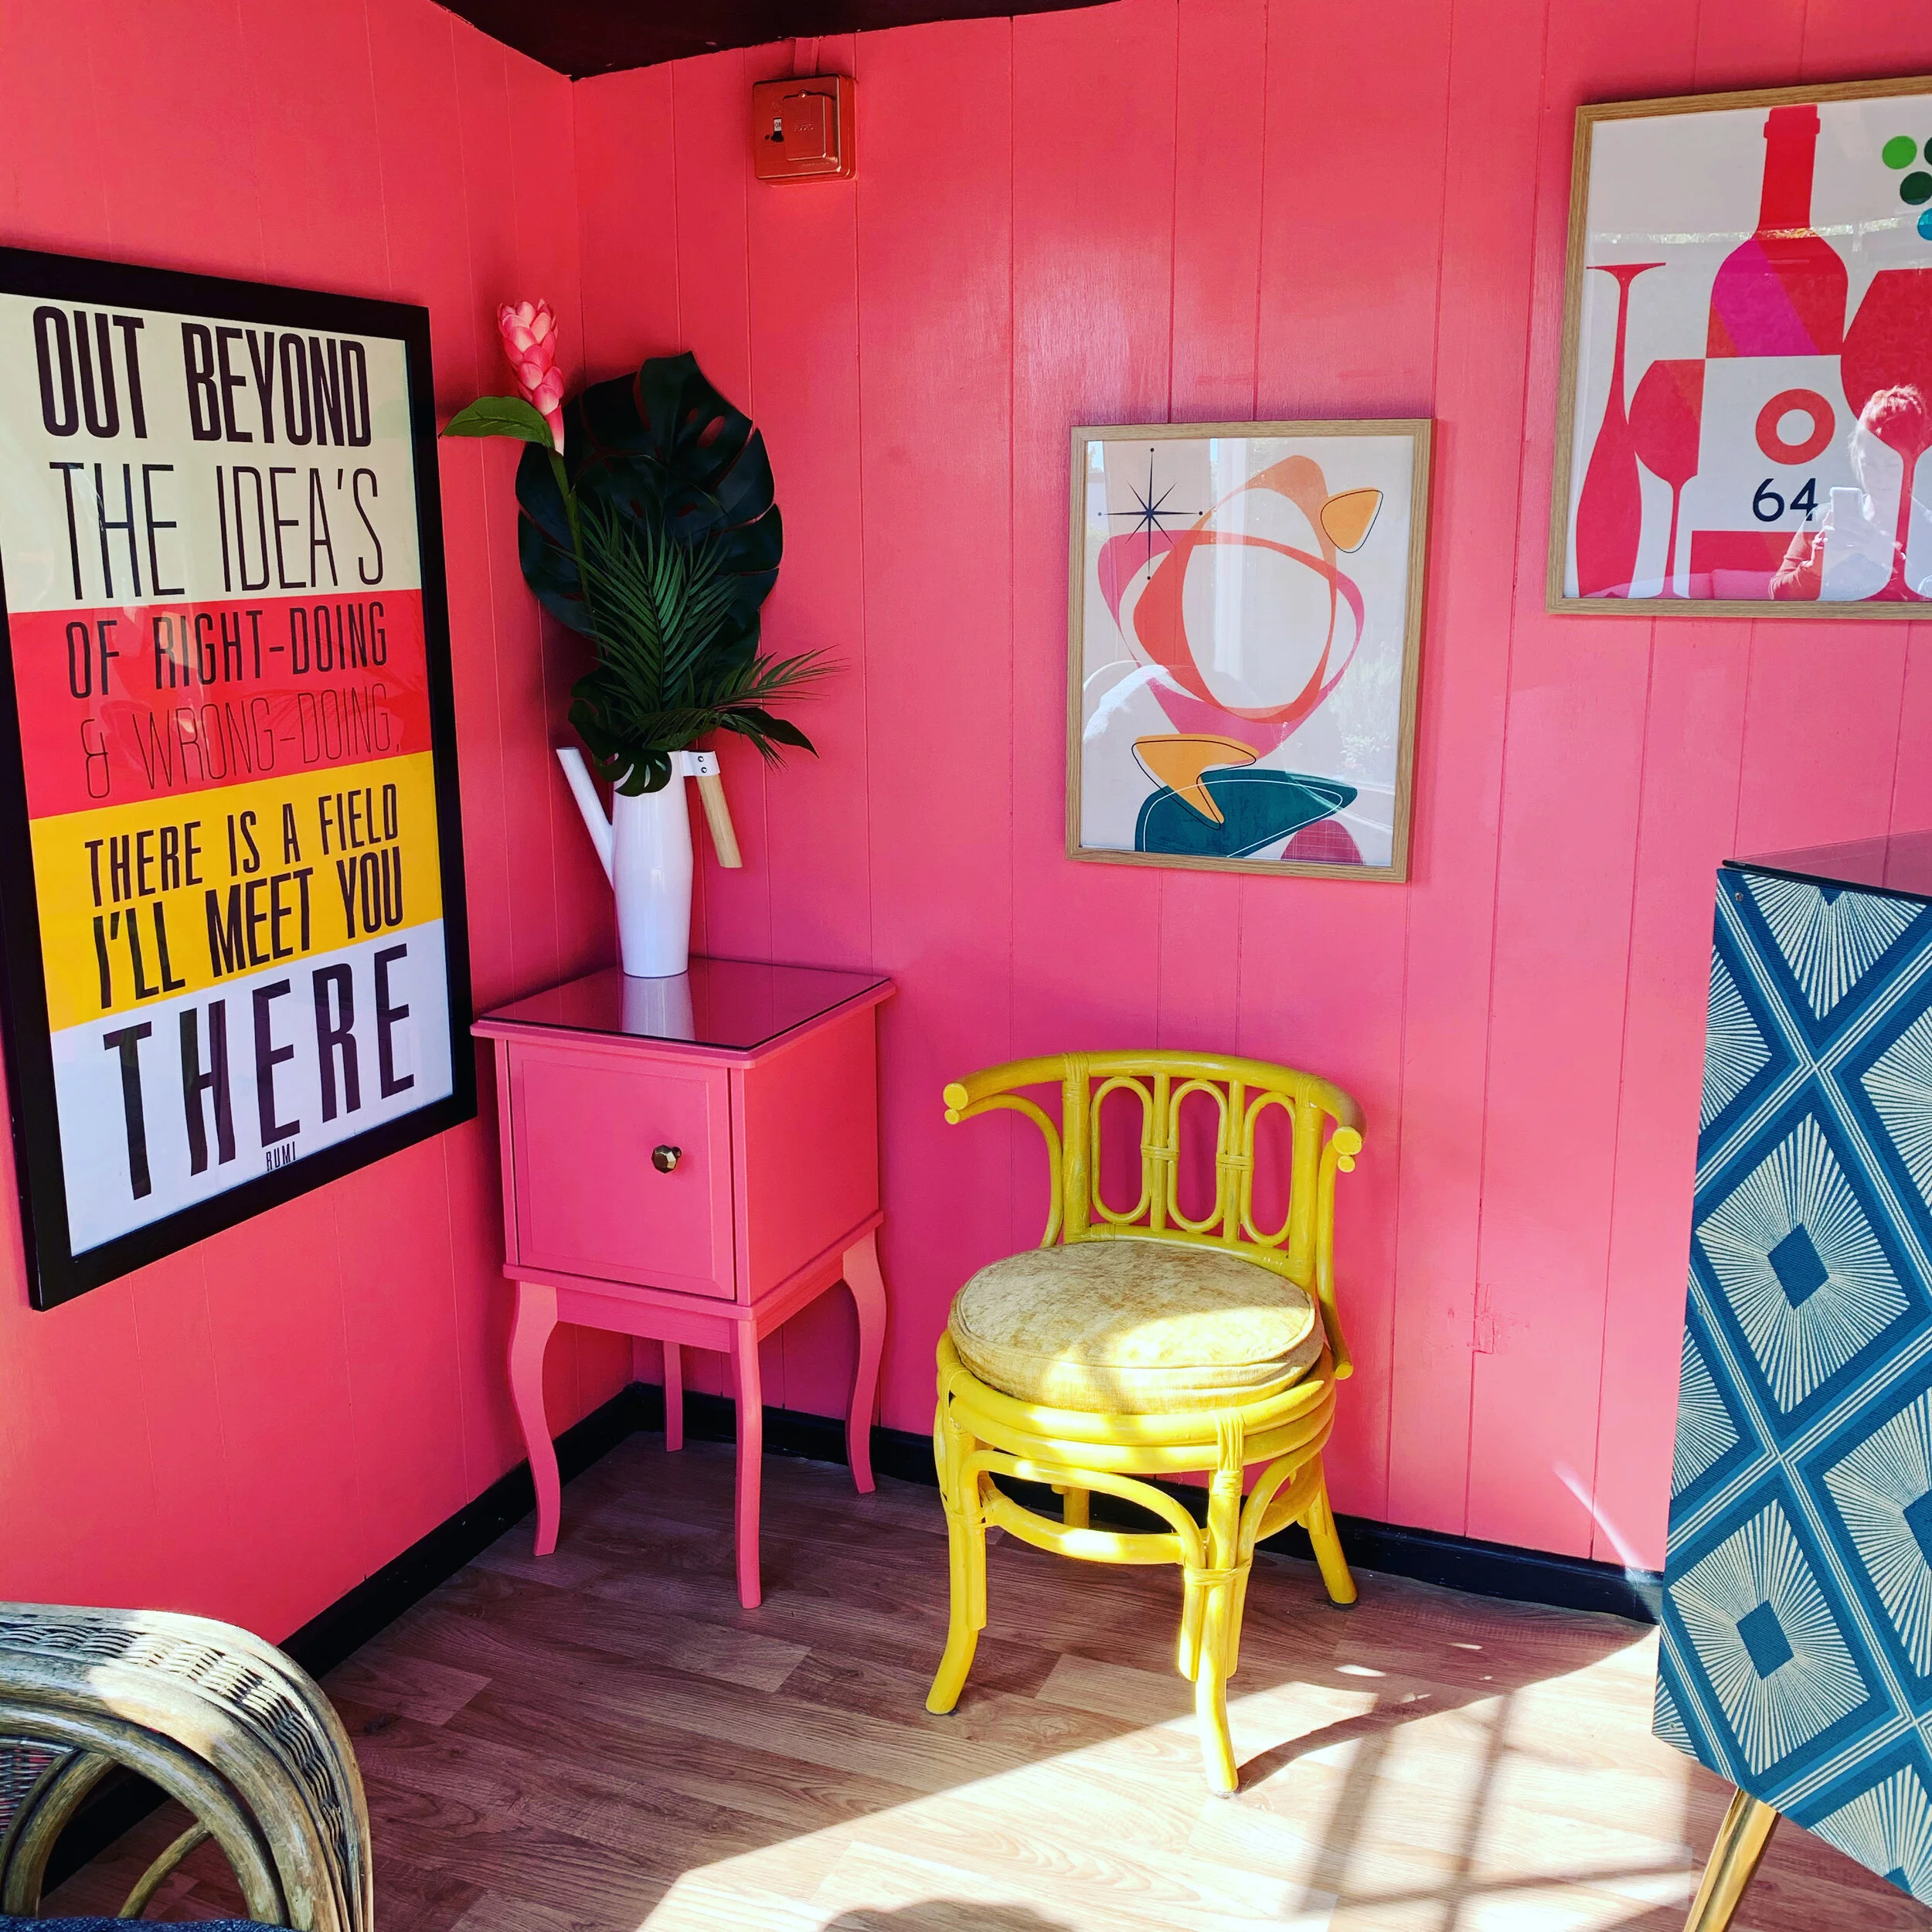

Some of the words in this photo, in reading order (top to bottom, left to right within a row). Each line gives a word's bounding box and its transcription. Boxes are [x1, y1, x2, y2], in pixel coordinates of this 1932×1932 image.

[33, 306, 148, 438] OUT
[181, 322, 372, 447] BEYOND
[49, 461, 185, 600] THE
[216, 465, 383, 592] IDEA'S
[1753, 478, 1818, 522] 64
[66, 620, 120, 699] OF
[152, 601, 387, 689] RIGHT-DOING
[80, 718, 110, 798] &
[132, 683, 400, 790] WRONG-DOING,
[85, 821, 202, 906] THERE
[227, 811, 257, 876] IS
[282, 803, 301, 866] A
[318, 784, 398, 855] FIELD
[93, 901, 185, 1009] I'LL
[205, 868, 313, 978] MEET
[336, 845, 403, 939] YOU
[103, 944, 414, 1201] THERE
[266, 1141, 297, 1172] RUMI
